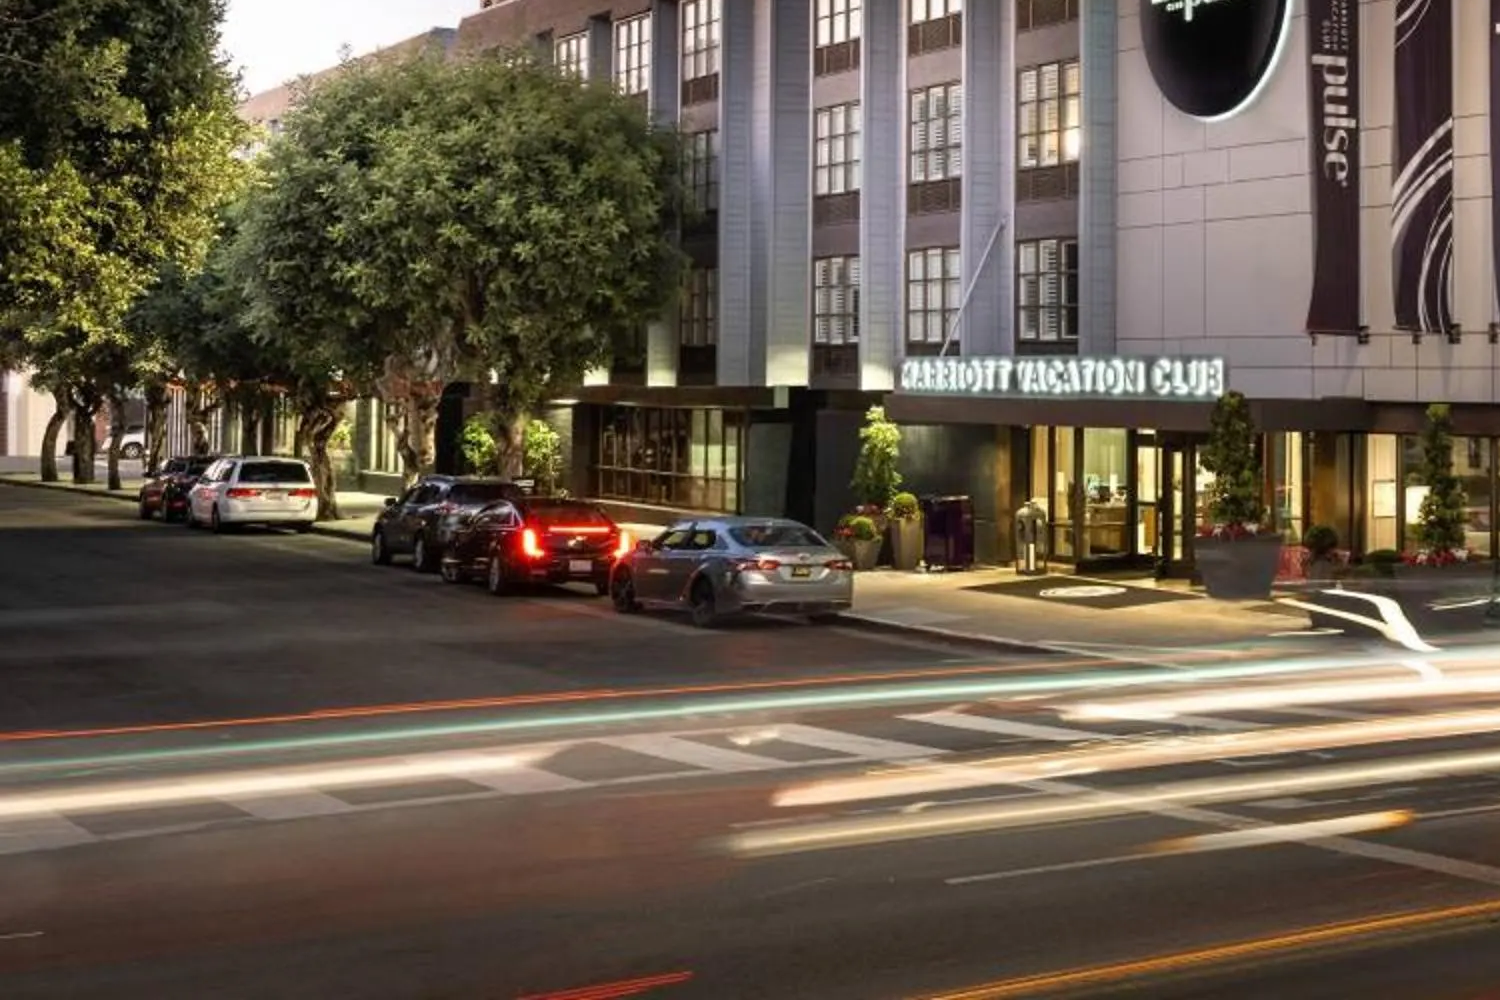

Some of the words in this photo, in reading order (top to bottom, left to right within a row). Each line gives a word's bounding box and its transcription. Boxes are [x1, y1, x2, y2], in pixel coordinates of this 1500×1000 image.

[1311, 53, 1357, 181] pulse
[901, 358, 1013, 392] MARRIOTT
[1015, 358, 1146, 394] VACATION
[1151, 358, 1223, 396] CLUB
